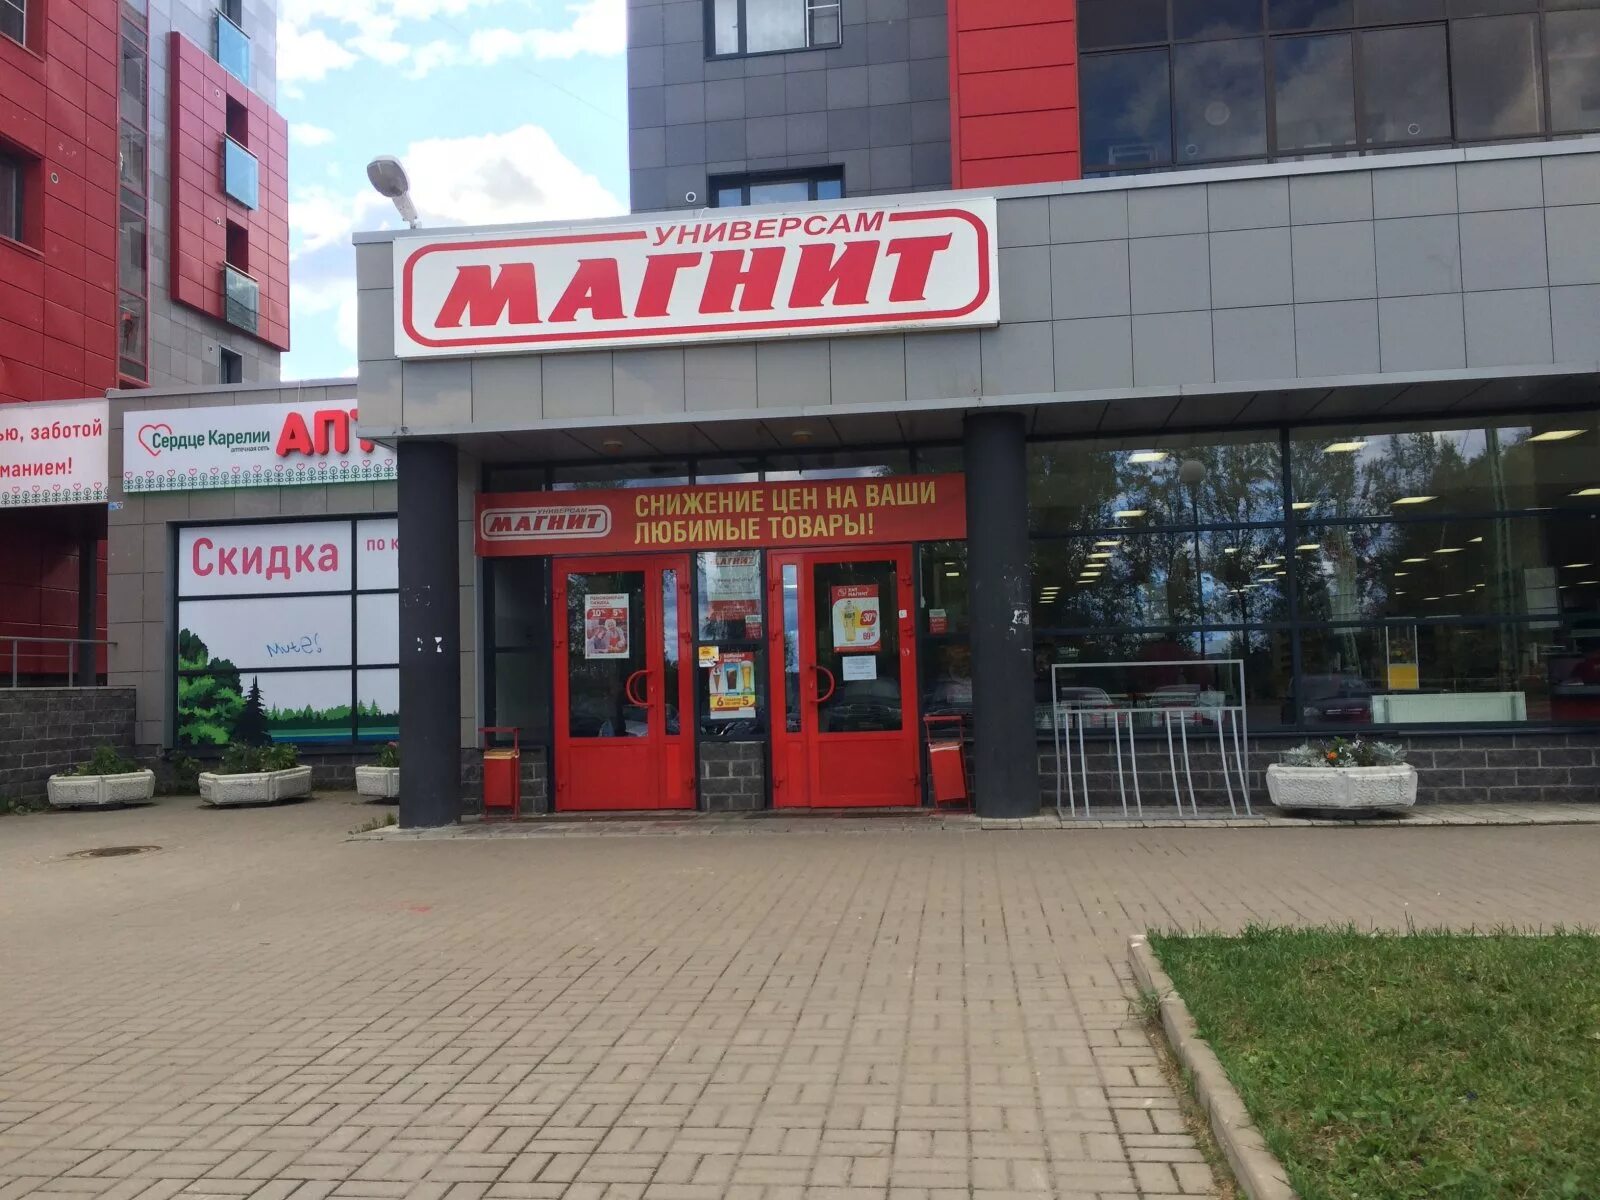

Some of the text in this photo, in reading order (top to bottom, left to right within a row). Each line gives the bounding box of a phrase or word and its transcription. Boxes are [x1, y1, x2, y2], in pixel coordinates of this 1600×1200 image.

[652, 211, 886, 247] УНИВЕРСАМ
[434, 232, 953, 328] МАГНИТ
[30, 418, 102, 441] заботой
[152, 429, 270, 451] Сердце Карелии
[635, 481, 936, 517] СНИЖЕНИЕ ЦЕН НА ВАШИ
[536, 507, 588, 515] УНИВЕРСАМ
[489, 514, 601, 532] МАГНИТ
[634, 512, 875, 545] ЛЮБИМЫЕ ТОВАРЫ!
[367, 538, 385, 551] по
[192, 537, 339, 580] Скидка
[717, 697, 725, 707] 6
[743, 696, 749, 705] 5
